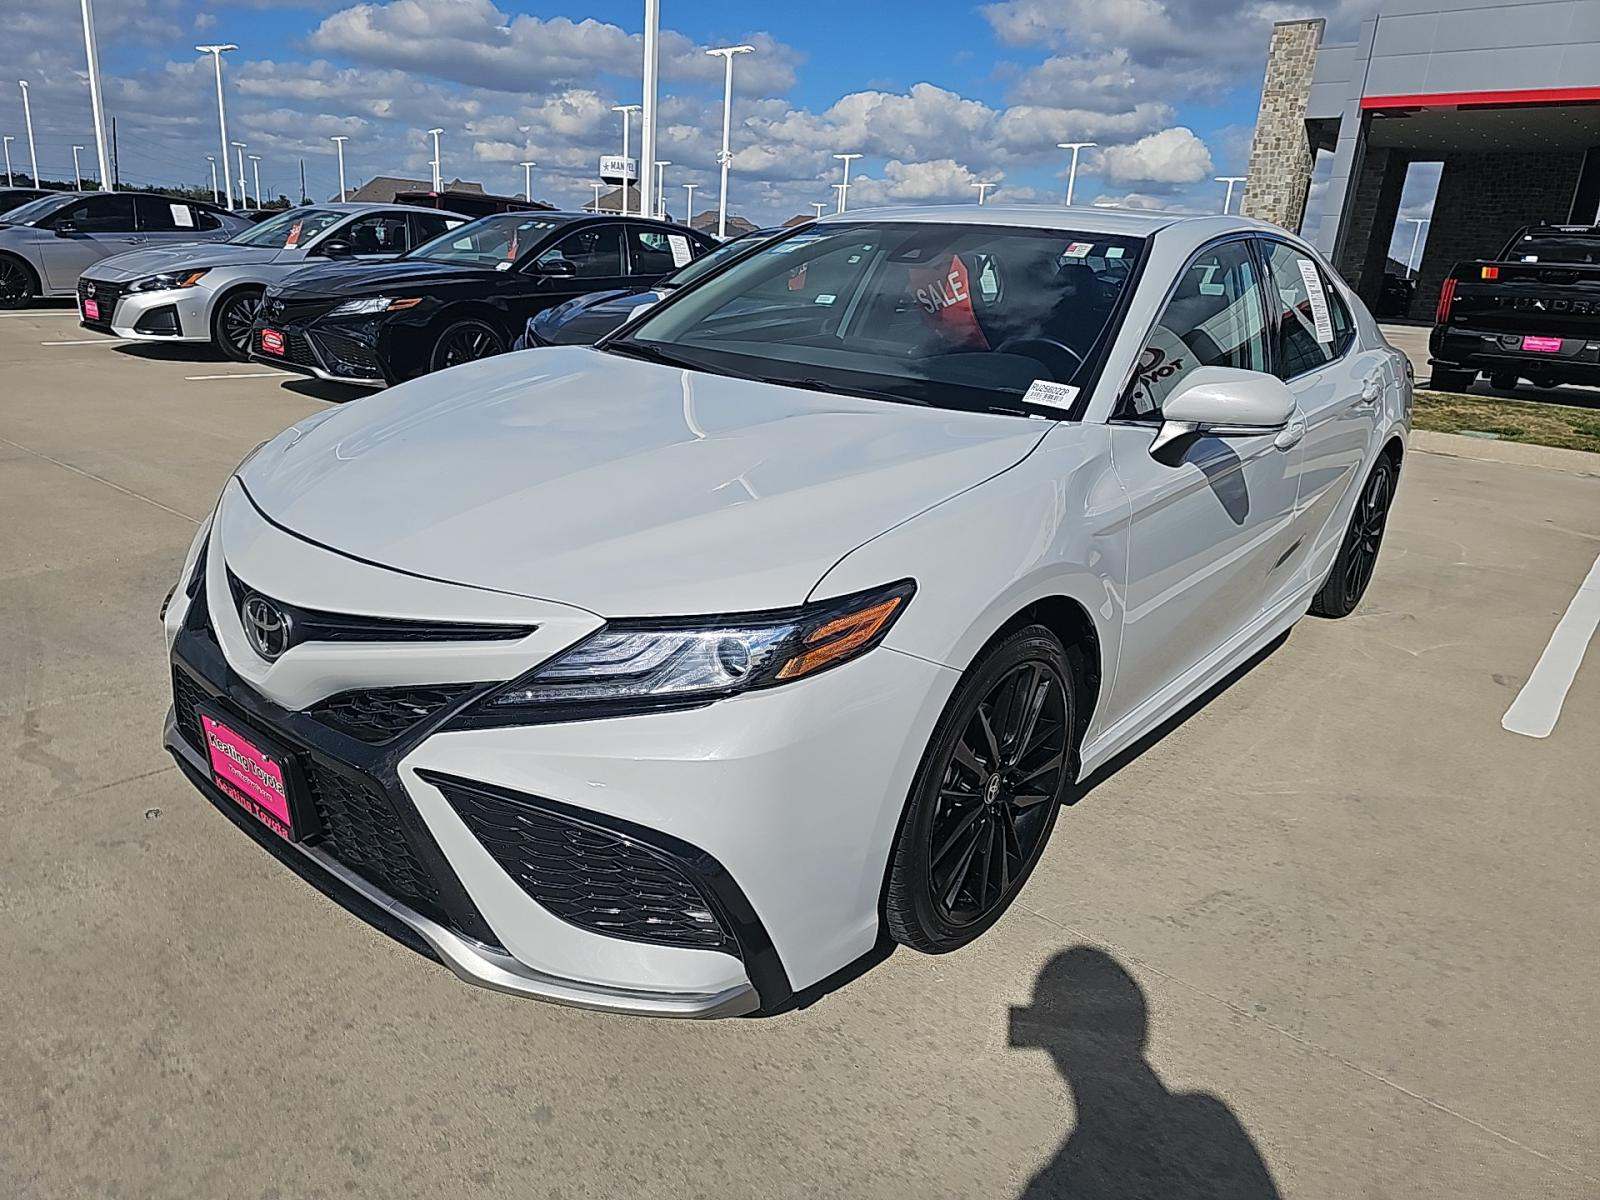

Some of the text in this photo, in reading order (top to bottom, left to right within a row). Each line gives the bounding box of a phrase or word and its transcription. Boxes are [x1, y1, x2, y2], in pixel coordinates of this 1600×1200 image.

[916, 270, 968, 314] SALE
[207, 731, 250, 772] Keating
[246, 758, 285, 797] Toyota
